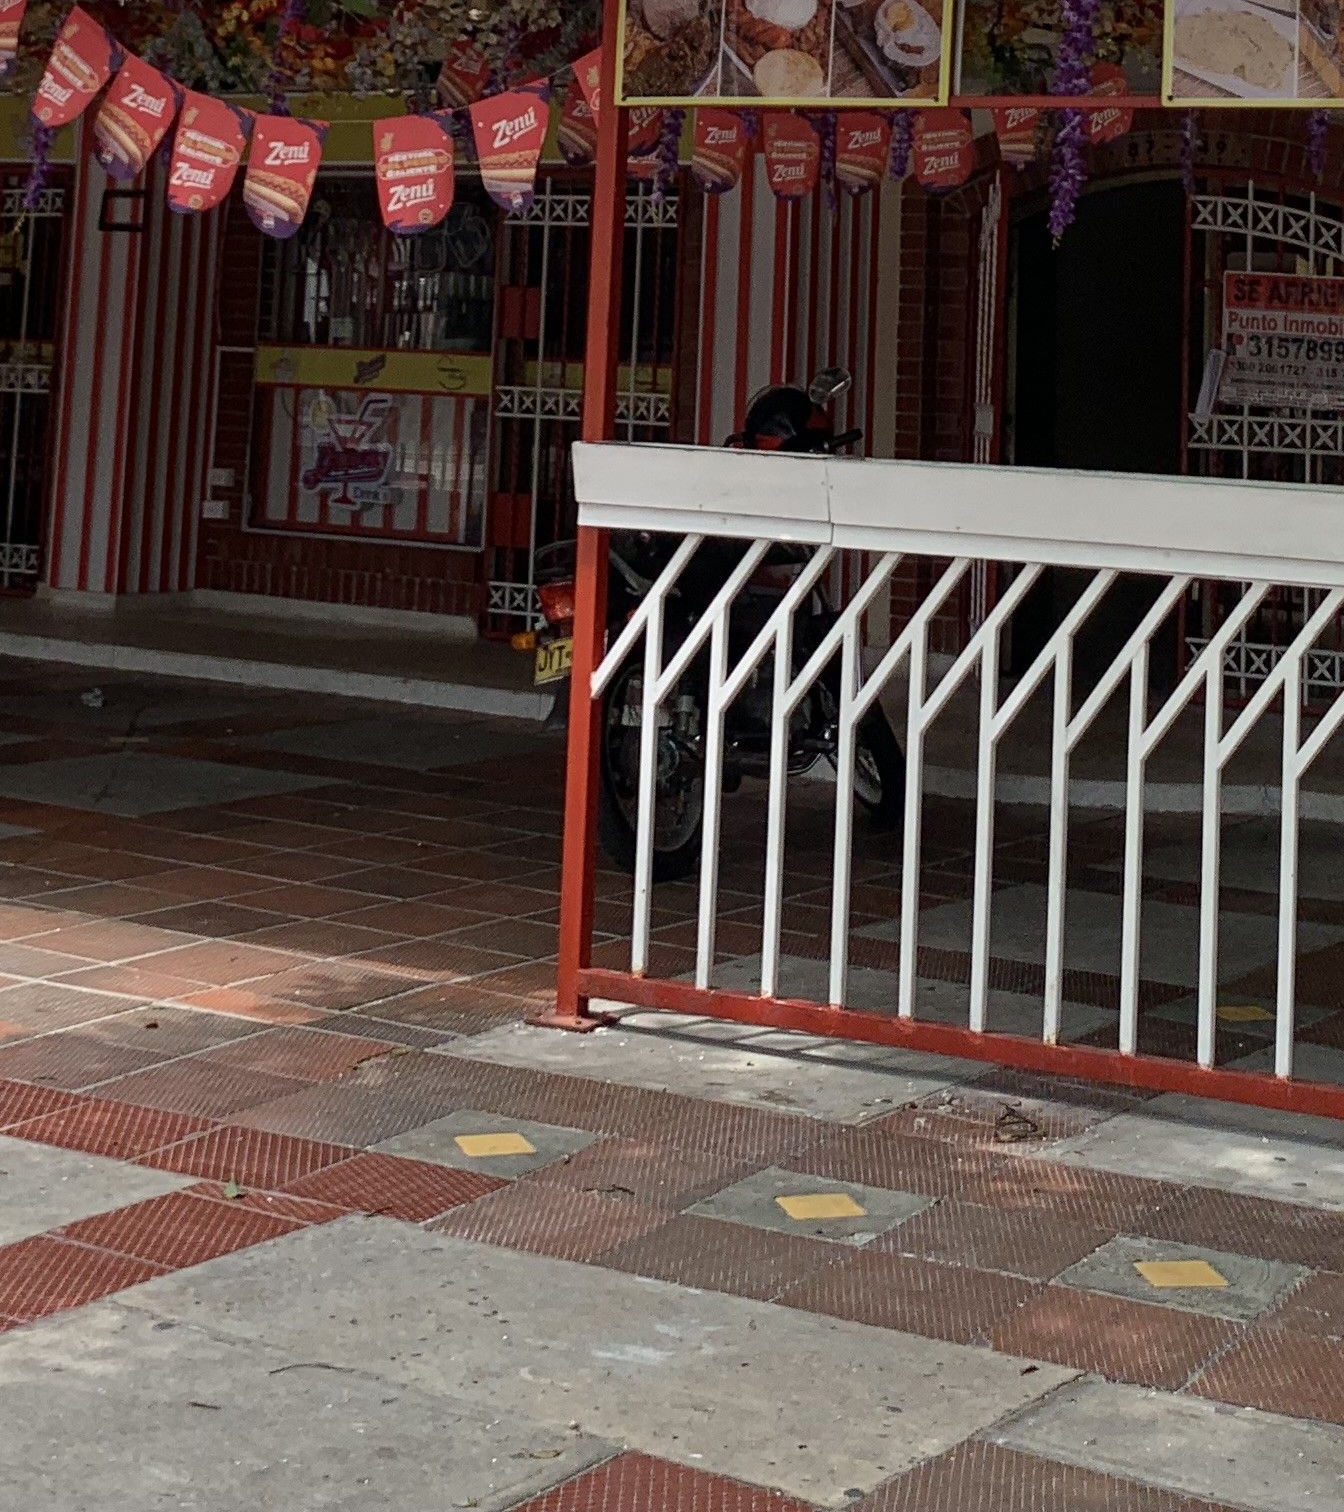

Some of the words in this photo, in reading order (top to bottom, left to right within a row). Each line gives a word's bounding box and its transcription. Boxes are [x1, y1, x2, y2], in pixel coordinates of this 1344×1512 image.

[120, 83, 167, 118] Zenú
[491, 106, 538, 149] Zenú
[264, 140, 310, 166] Zenú
[169, 160, 215, 189] Zenú
[387, 178, 436, 212] Zenú
[1233, 279, 1261, 302] SE
[1228, 311, 1278, 331] Punto
